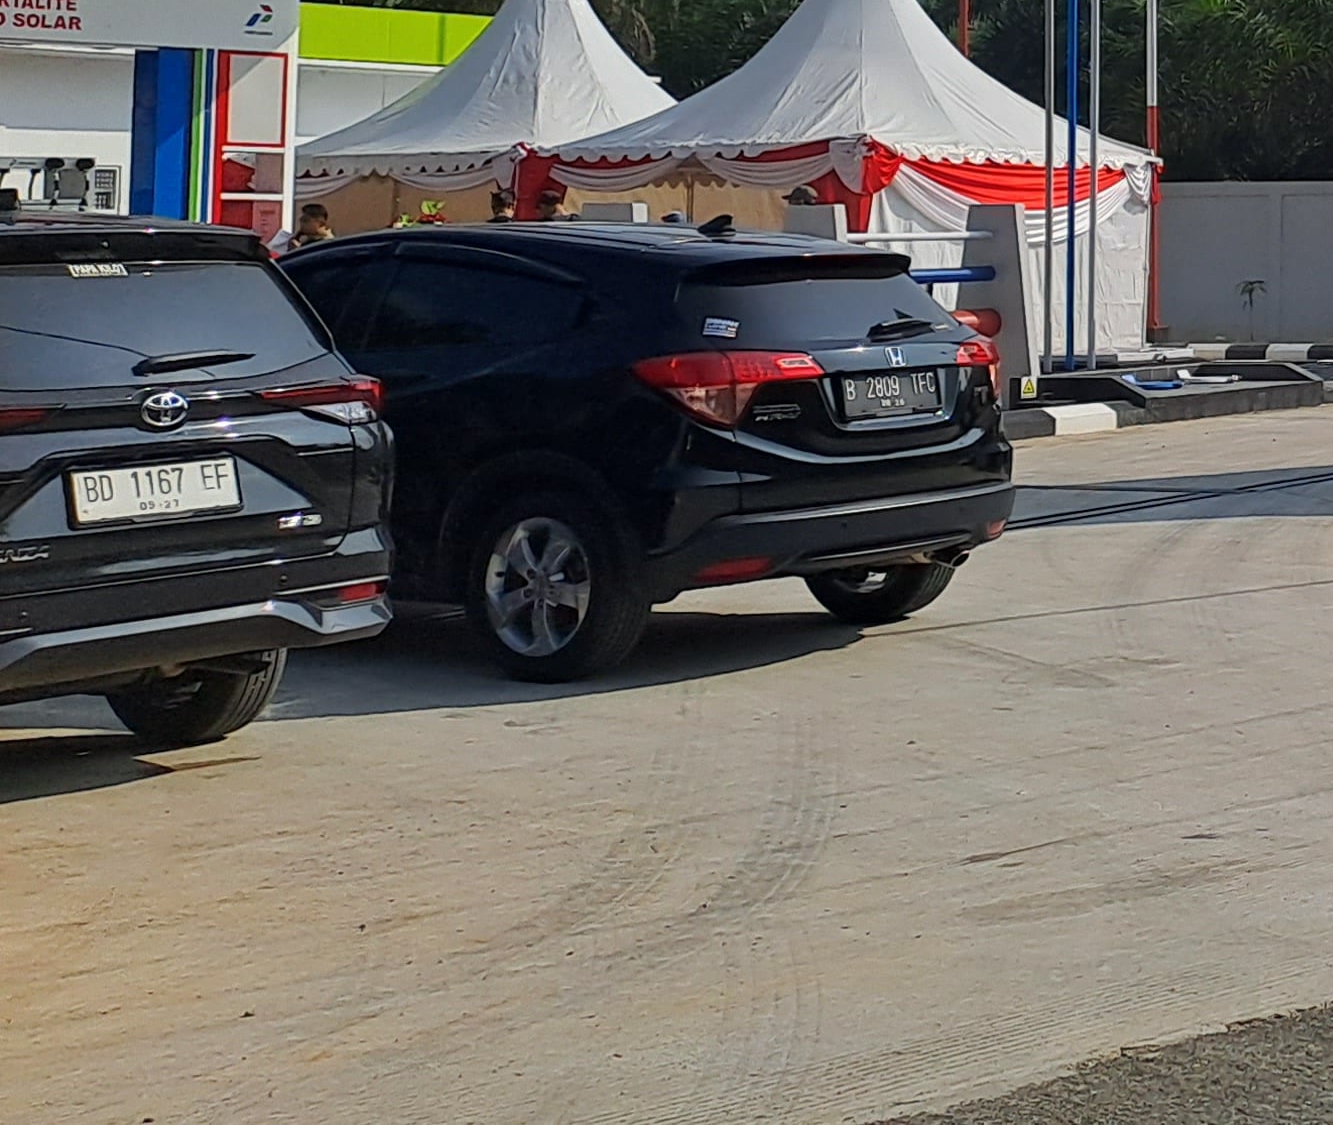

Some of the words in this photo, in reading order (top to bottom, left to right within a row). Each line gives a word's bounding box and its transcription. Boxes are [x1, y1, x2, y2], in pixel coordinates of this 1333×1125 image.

[12, 13, 82, 31] SOLAR
[844, 378, 857, 402] B
[865, 375, 900, 399] 2809
[910, 371, 937, 395] TFC
[83, 475, 115, 503] BD
[130, 467, 185, 498] 1167
[200, 462, 227, 491] EF
